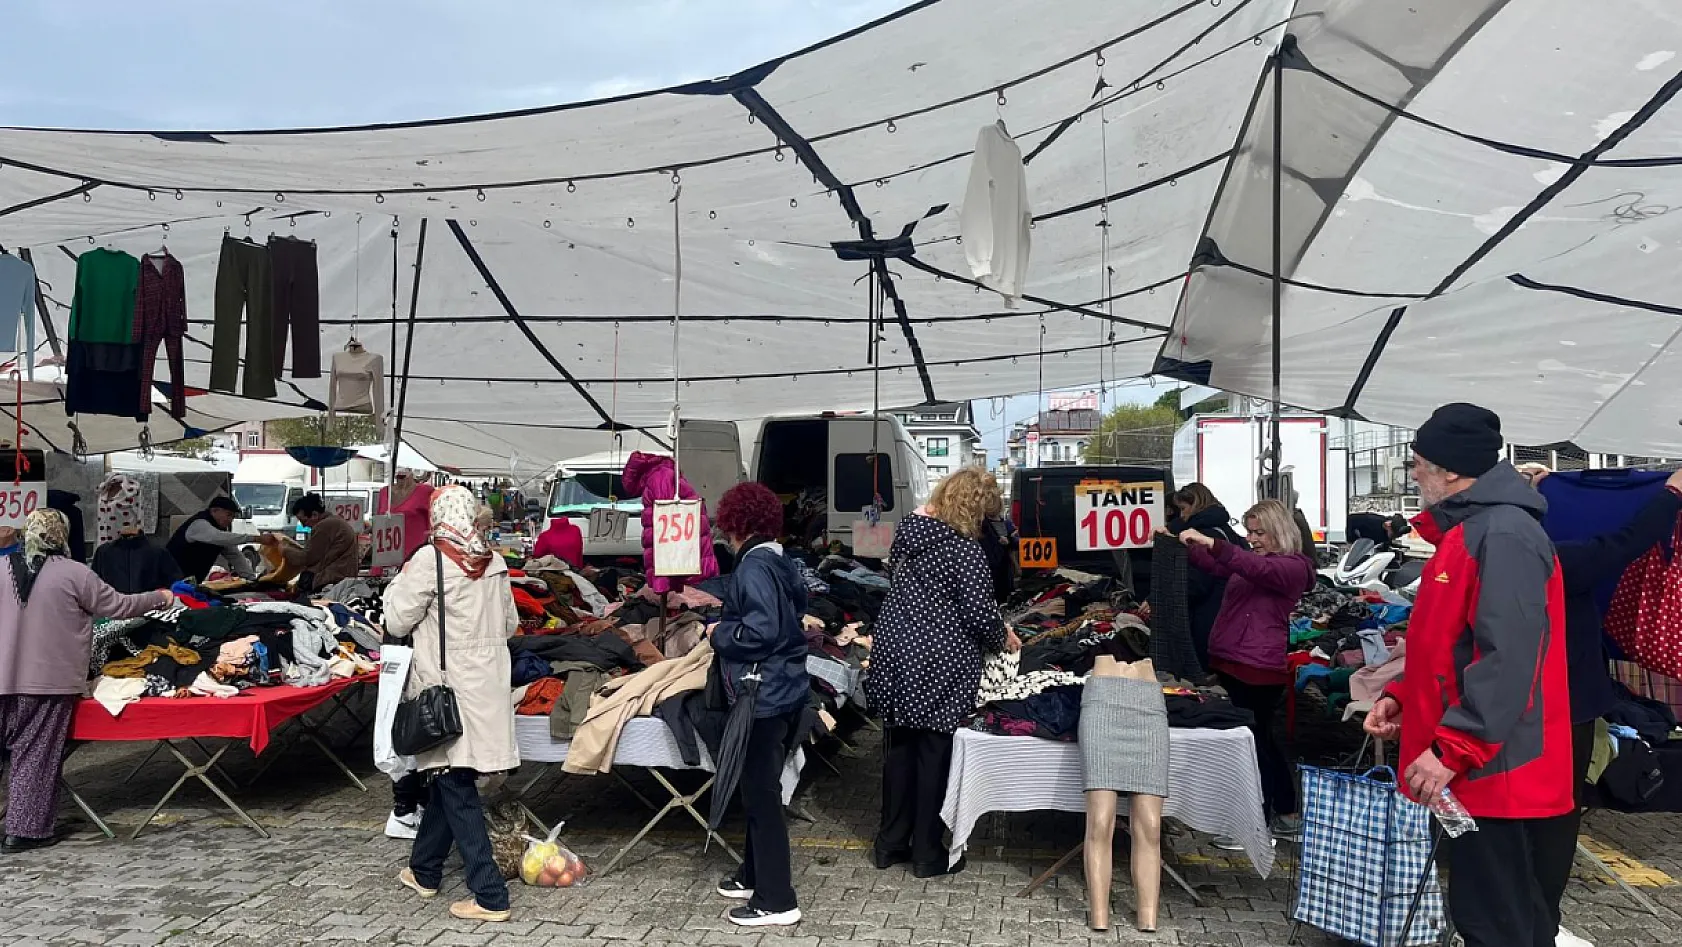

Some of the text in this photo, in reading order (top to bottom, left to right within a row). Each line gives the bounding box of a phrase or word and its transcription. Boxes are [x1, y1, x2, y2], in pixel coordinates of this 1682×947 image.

[1087, 487, 1154, 508] TANE
[376, 525, 402, 553] 150
[658, 512, 695, 544] 250
[1080, 508, 1150, 548] 100
[1023, 540, 1052, 562] 100
